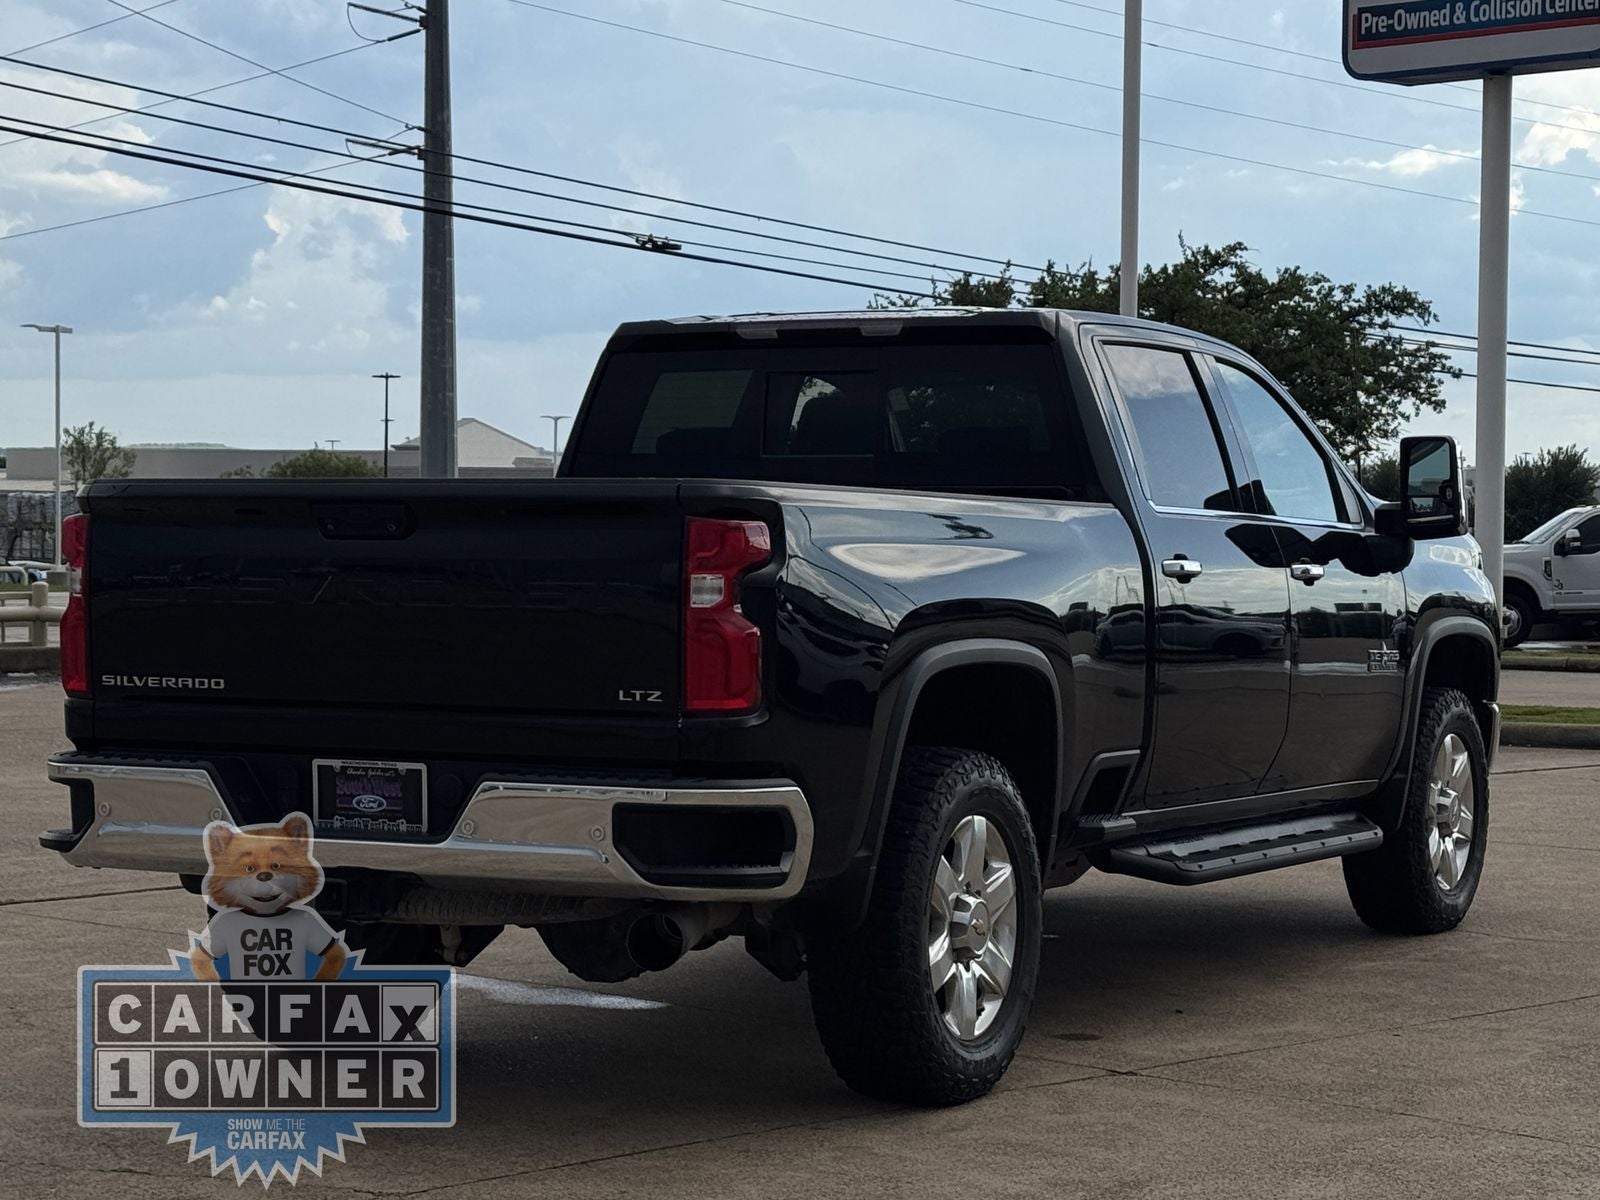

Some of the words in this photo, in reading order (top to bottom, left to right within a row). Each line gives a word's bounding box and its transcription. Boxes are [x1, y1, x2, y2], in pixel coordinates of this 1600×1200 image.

[1361, 3, 1450, 35] Pre-Owned
[1453, 3, 1466, 25] &
[1469, 0, 1542, 23] Collision
[101, 674, 225, 689] SILVERADO
[618, 689, 663, 702] LTZ
